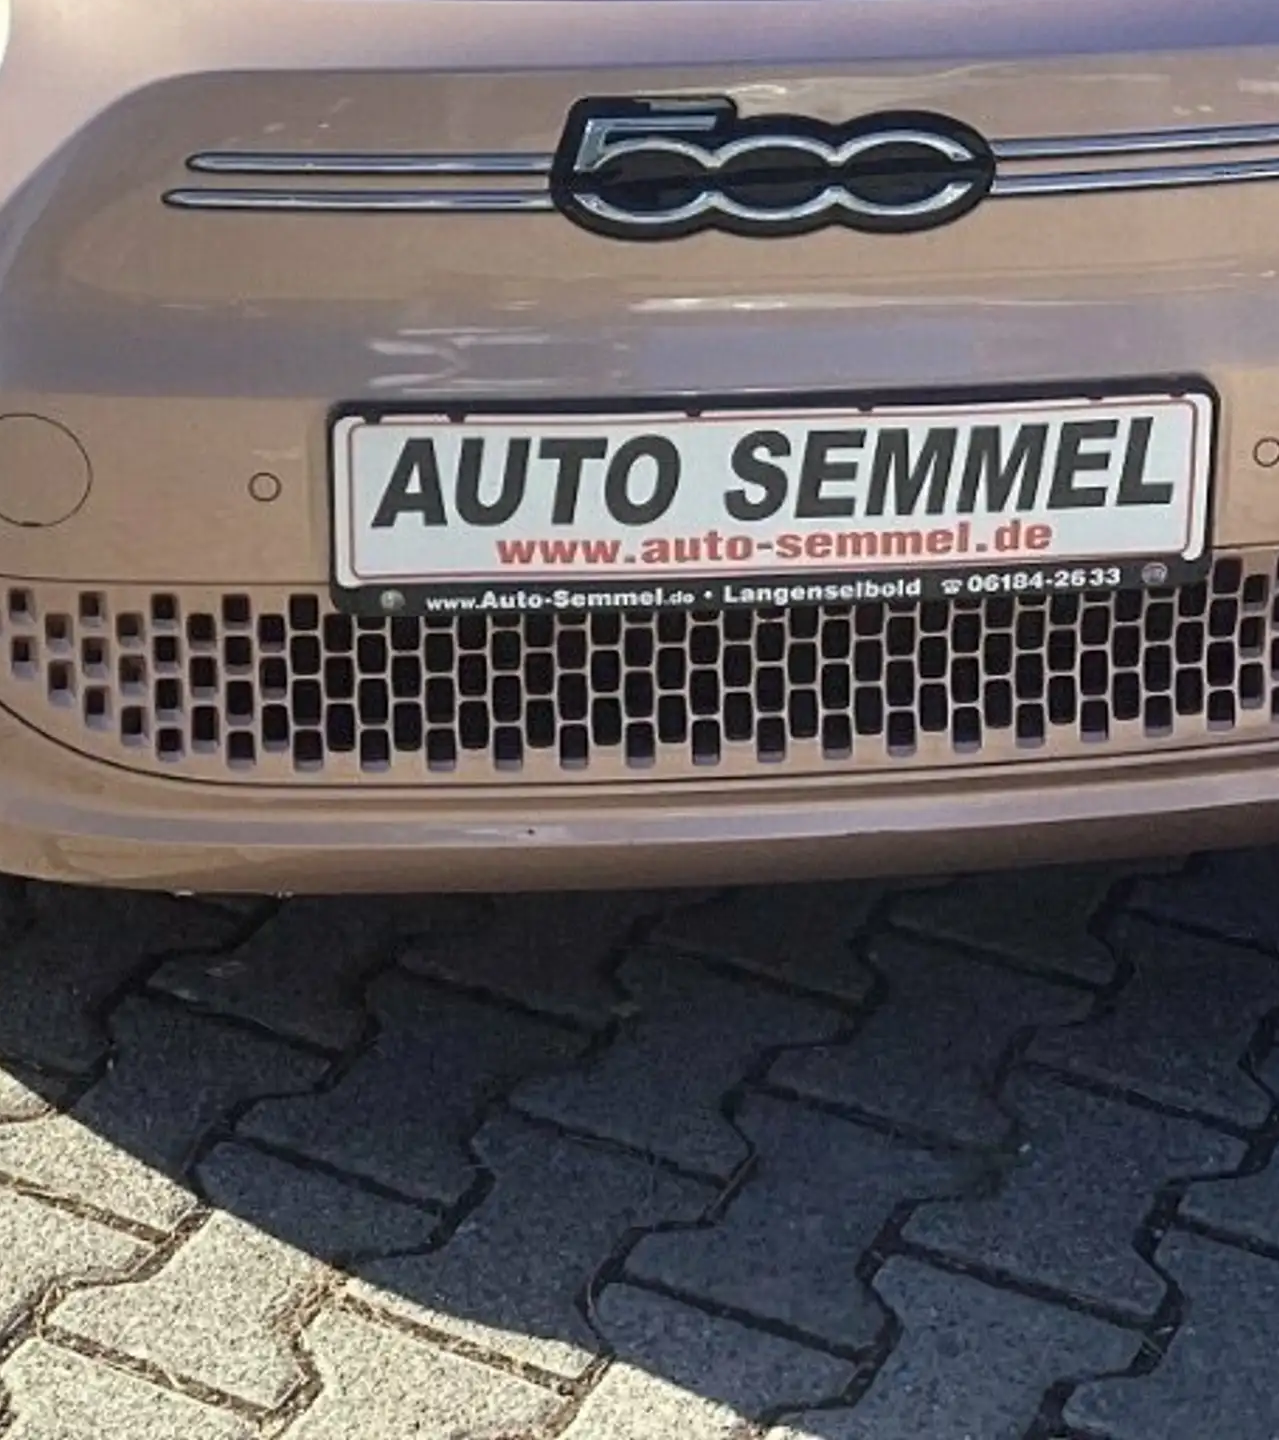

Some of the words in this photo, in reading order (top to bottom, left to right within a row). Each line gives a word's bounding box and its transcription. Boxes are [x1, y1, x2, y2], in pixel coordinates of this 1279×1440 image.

[554, 98, 994, 238] 500
[371, 433, 682, 528] AUTO
[723, 416, 1175, 522] SEMMEL
[495, 518, 1053, 565] www.auto-semmel.de
[425, 587, 696, 611] www.Auto-Semmel.de
[723, 578, 922, 605] Langenselbold
